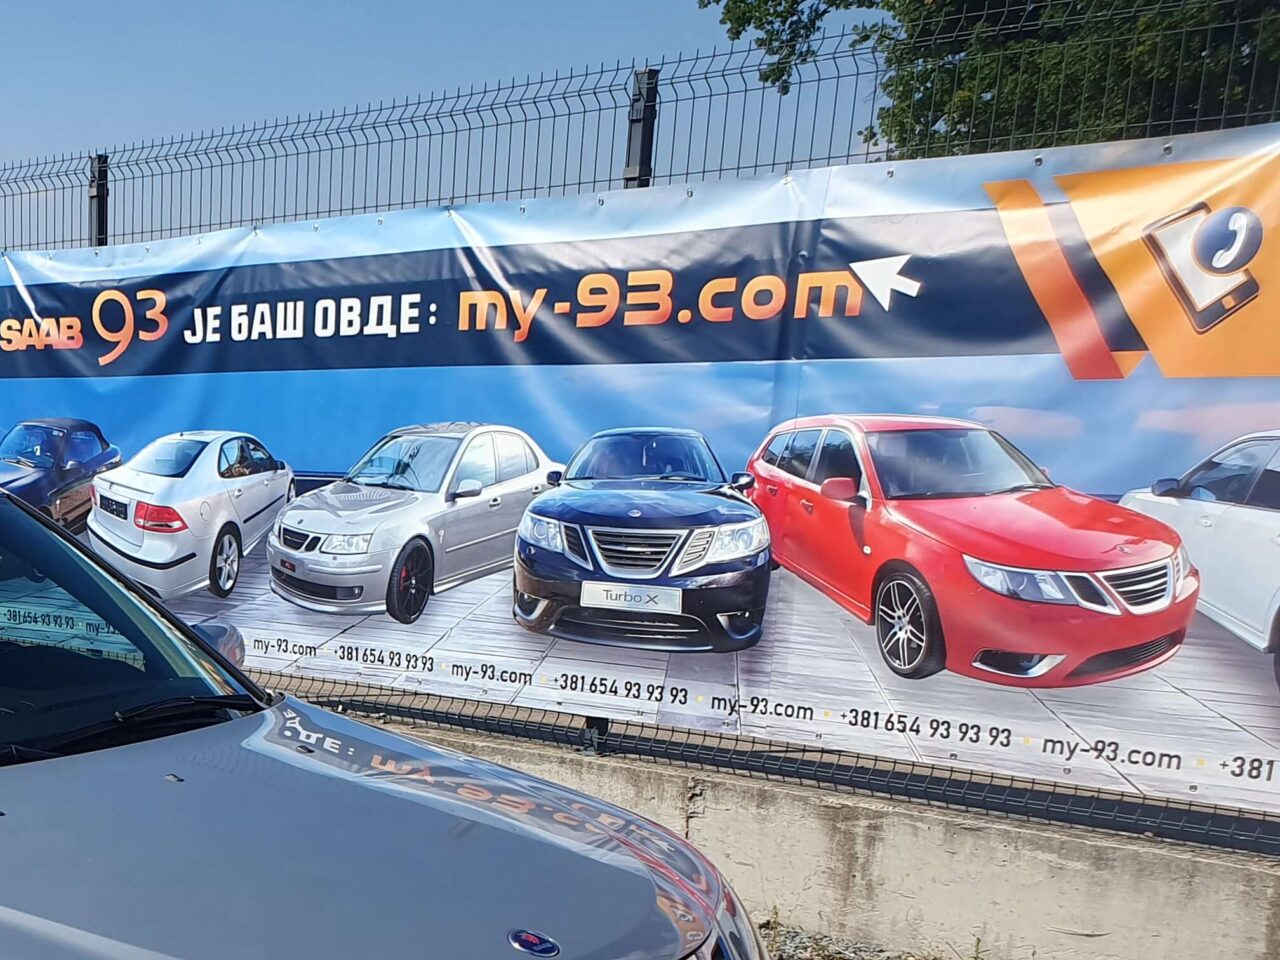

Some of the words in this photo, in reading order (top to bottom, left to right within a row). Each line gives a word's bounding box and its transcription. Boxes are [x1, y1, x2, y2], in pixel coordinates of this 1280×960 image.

[0, 316, 85, 352] SAAB
[91, 289, 170, 366] 93
[183, 306, 222, 344] ЈЕ
[230, 300, 305, 342] БАШ
[457, 268, 864, 343] my-93.com
[40, 613, 52, 627] 93
[53, 614, 64, 629] 93
[64, 616, 75, 630] 93
[602, 588, 643, 603] Turbo
[644, 593, 660, 606] X
[253, 638, 318, 658] my-93.com
[333, 645, 359, 662] +381
[362, 648, 385, 665] 654
[388, 650, 402, 667] 93
[405, 653, 418, 670] 93
[421, 656, 434, 673] 93
[451, 662, 533, 687] my-93.com
[553, 673, 585, 692] +381
[589, 676, 618, 697] 654
[624, 681, 641, 700] 93
[646, 684, 665, 702] 93
[670, 687, 688, 706] 93
[711, 692, 815, 722] my-93.com
[839, 708, 880, 730] +381
[884, 713, 921, 736] 654
[929, 718, 951, 740] 93
[958, 722, 981, 744] 93
[988, 726, 1012, 748] 93
[1041, 737, 1183, 770] my-93.com
[1219, 755, 1276, 782] +381
